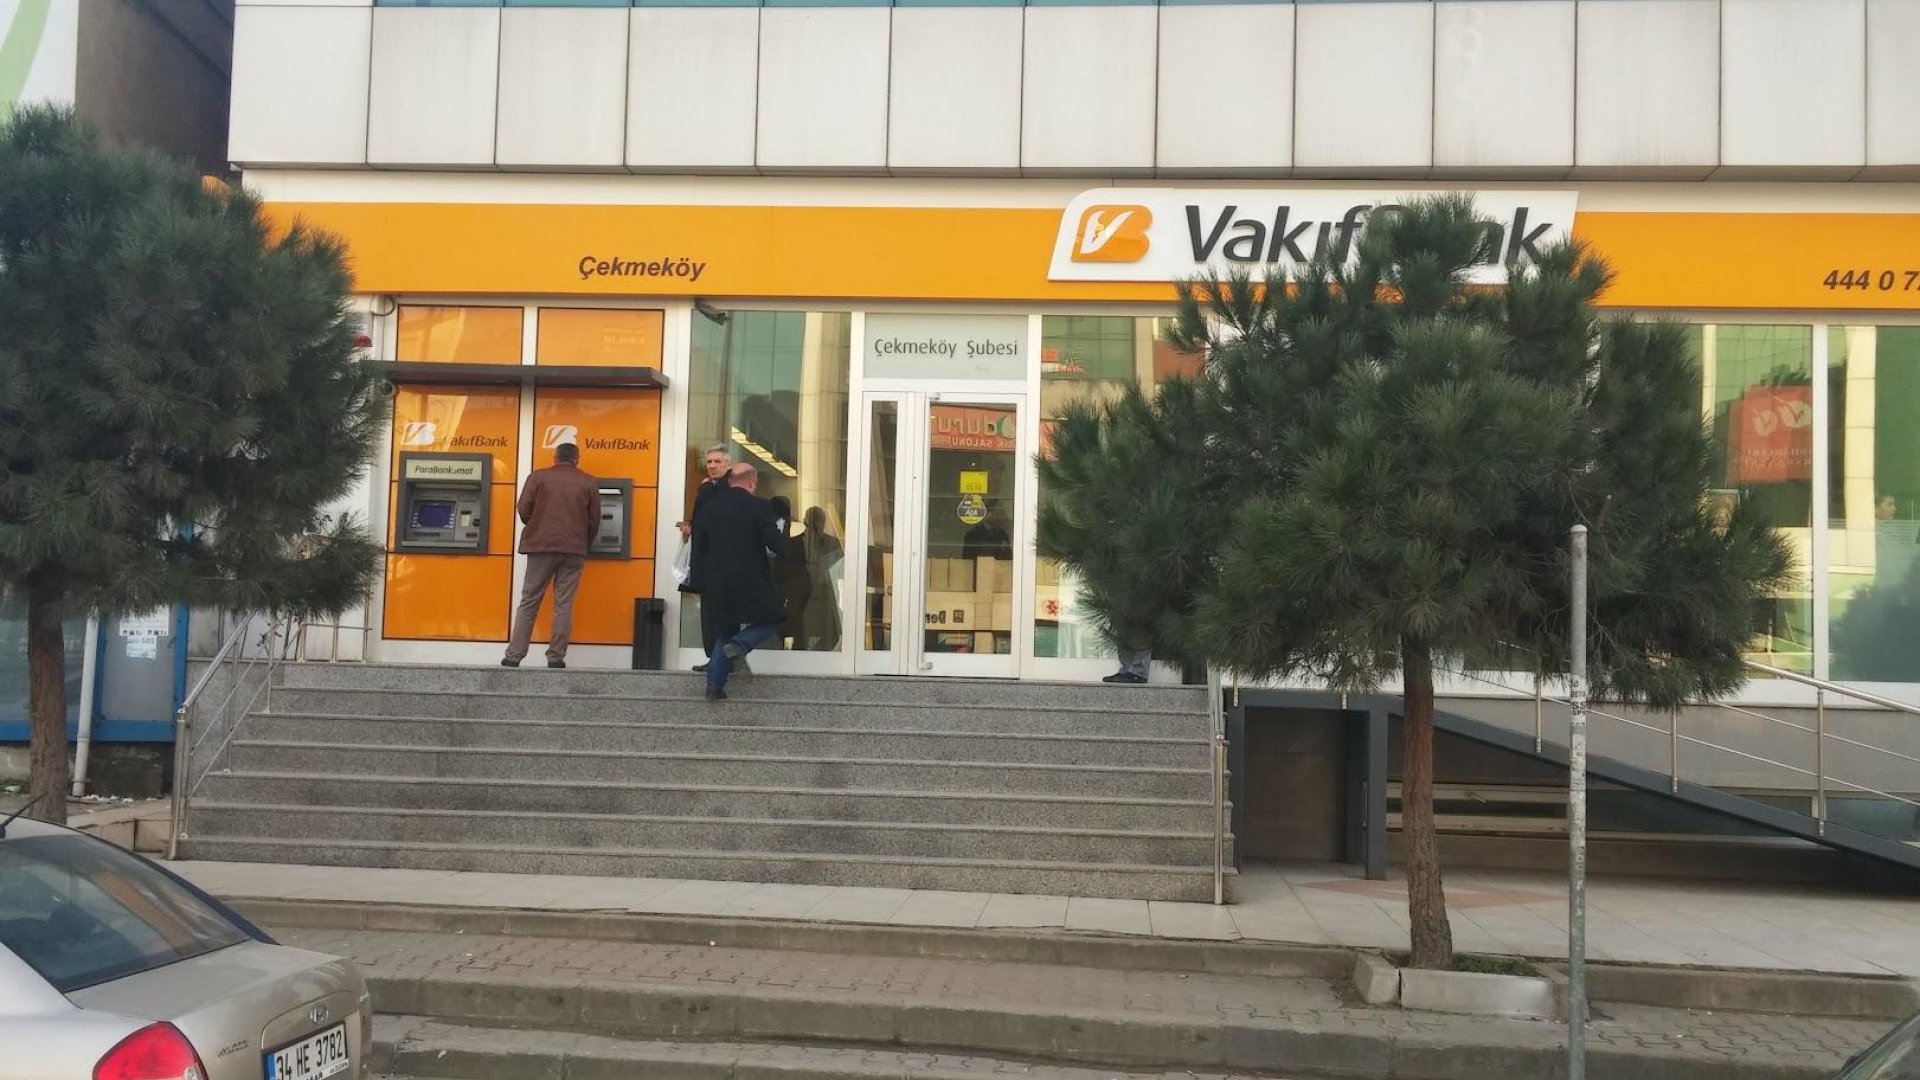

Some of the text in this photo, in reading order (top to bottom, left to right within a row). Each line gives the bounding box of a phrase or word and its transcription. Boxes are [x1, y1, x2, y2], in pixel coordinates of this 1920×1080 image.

[579, 256, 706, 281] Çekmeköy
[1823, 270, 1920, 291] 444 0 7
[874, 337, 1018, 358] Çekmeköy Şubesi
[585, 438, 651, 451] VakıfBank
[277, 1053, 291, 1080] 34
[296, 1043, 310, 1077] HE
[316, 1031, 343, 1067] 3782
